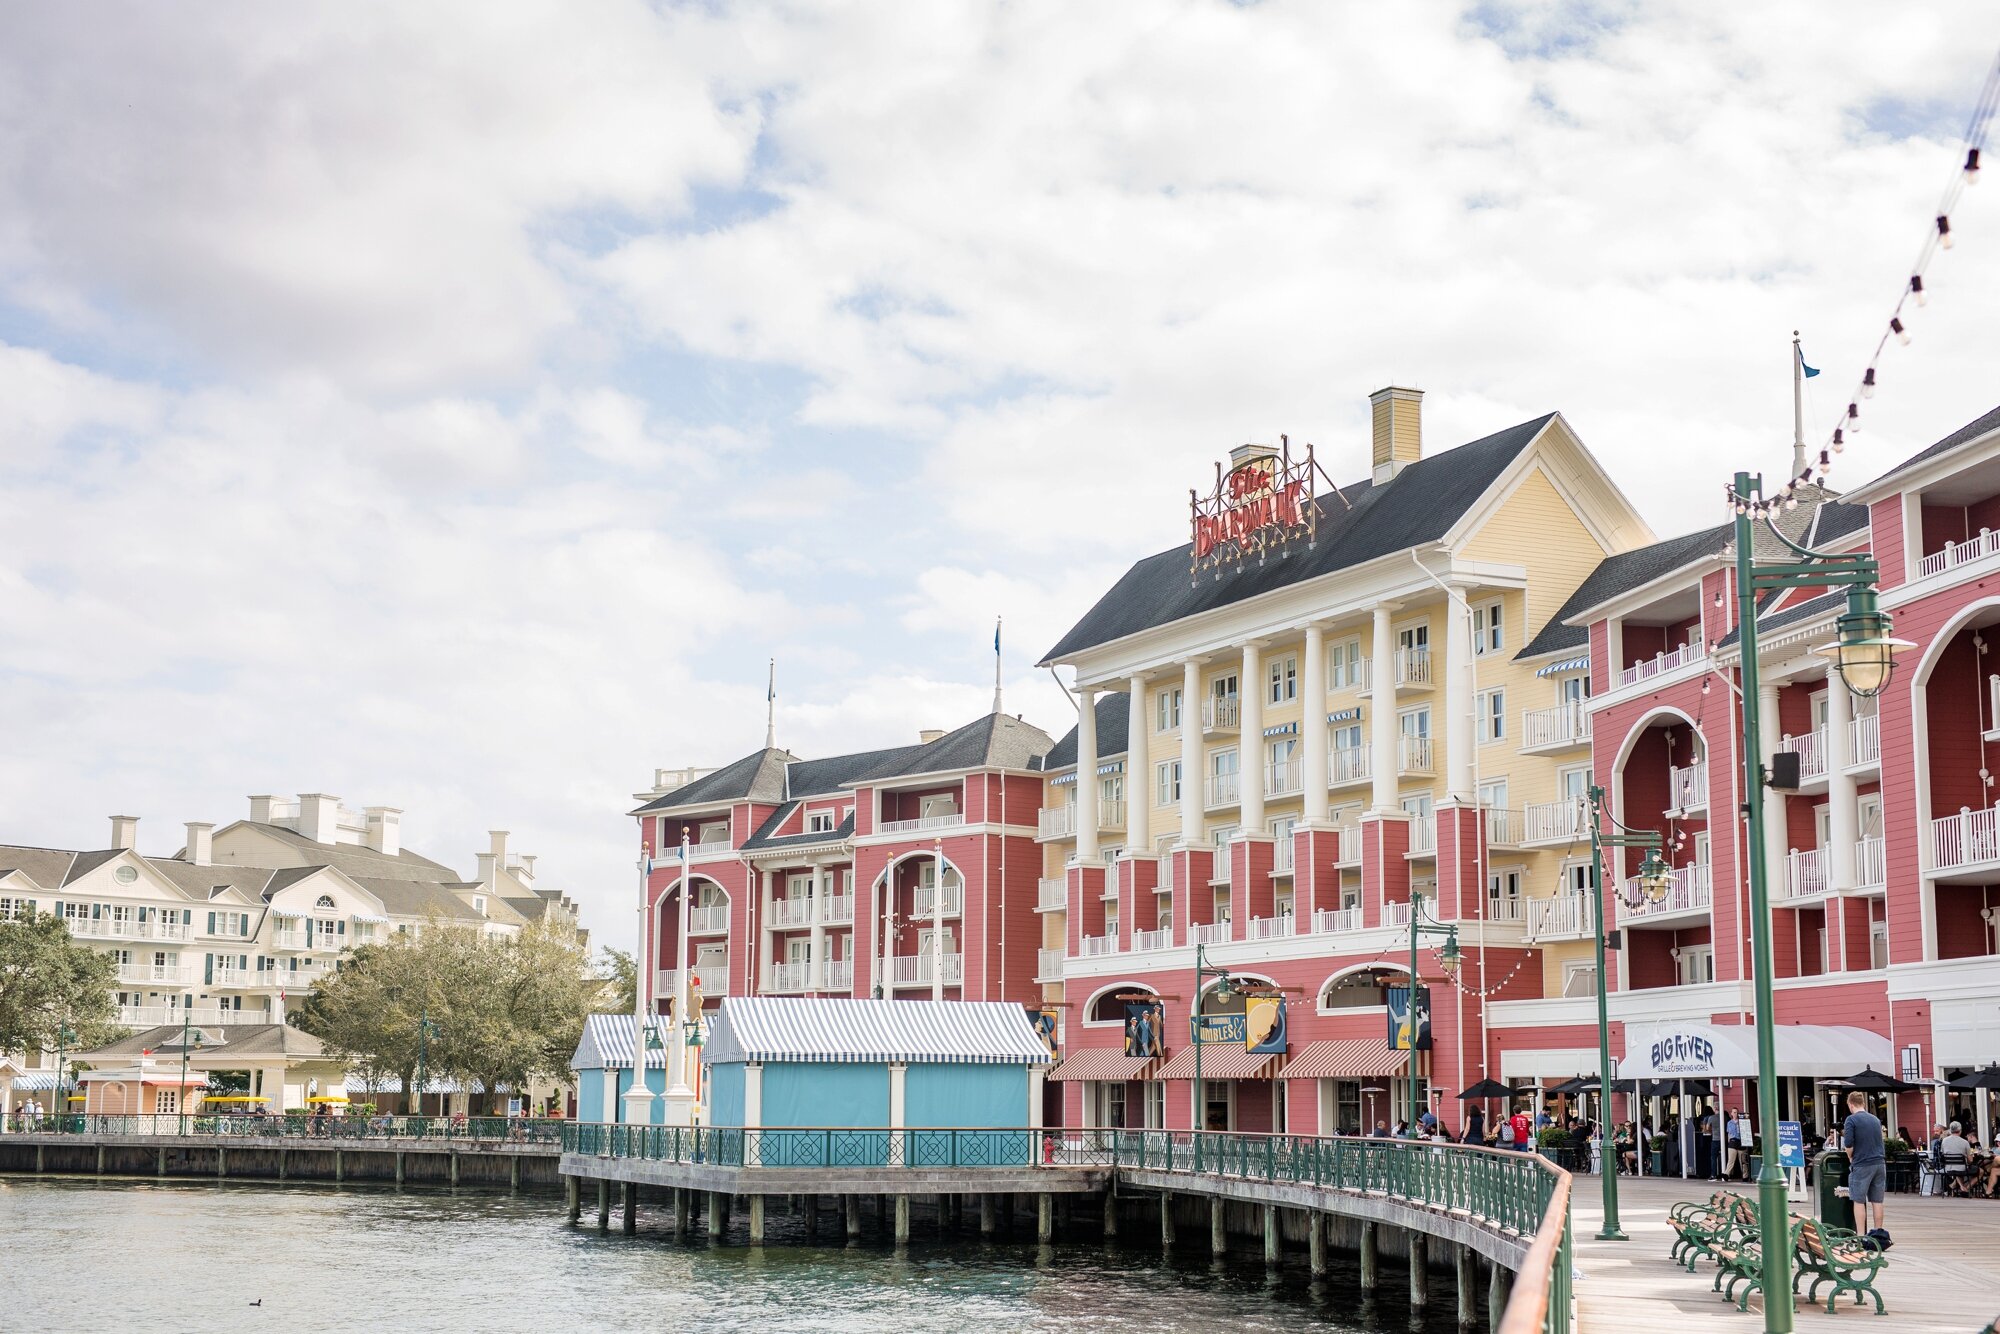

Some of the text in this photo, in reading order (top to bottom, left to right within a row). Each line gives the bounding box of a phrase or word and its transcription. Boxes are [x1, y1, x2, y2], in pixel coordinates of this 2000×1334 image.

[1229, 465, 1271, 499] The
[1196, 480, 1305, 557] BOARDWALK
[1651, 1037, 1674, 1069] BIG
